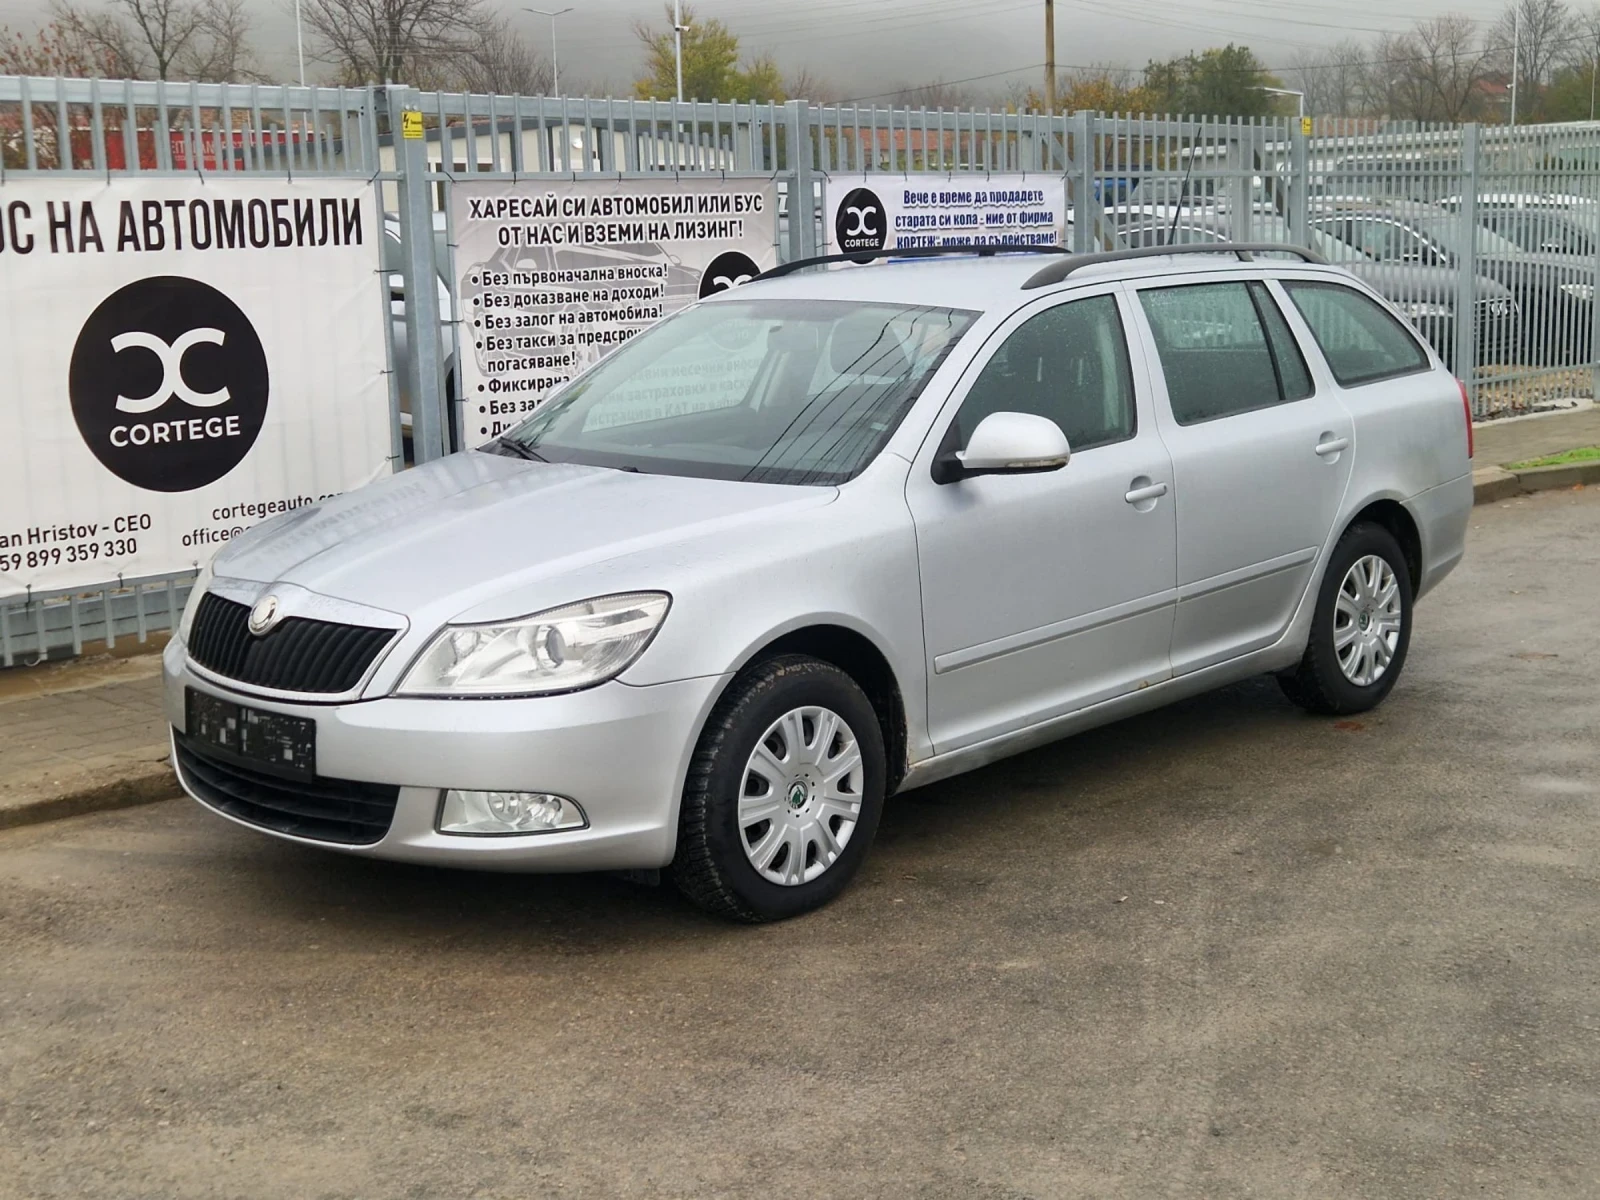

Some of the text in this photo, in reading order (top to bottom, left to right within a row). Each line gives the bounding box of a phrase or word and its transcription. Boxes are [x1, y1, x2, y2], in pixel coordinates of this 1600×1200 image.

[469, 193, 763, 219] ХАРЕСАЙ СИ АВТОМОБИЛ ИЛИ БУС
[904, 190, 1043, 205] Вече е време да продадете
[0, 198, 363, 255] С НА АВТОМОБИЛИ
[895, 215, 937, 228] старата
[939, 214, 951, 226] си
[953, 213, 978, 226] кола
[986, 213, 1005, 225] ние
[1006, 212, 1017, 224] от
[1019, 210, 1054, 224] фирма
[498, 219, 743, 246] ОТ НАС И ВЗЕМИ НА ЛИЗИНГ!
[844, 238, 880, 248] CORTEGE
[943, 236, 971, 246] може
[989, 231, 1057, 246] съдействаме!
[482, 263, 668, 287] Без първоначална вноска!
[483, 284, 664, 308] Без доказване на доходи!
[485, 303, 663, 330] Без залог на автомобила!
[486, 336, 513, 351] Без
[516, 334, 556, 348] такси
[560, 333, 575, 346] за
[487, 351, 576, 373] погасяване!
[489, 400, 516, 415] Без
[109, 415, 241, 447] CORTEGE
[27, 523, 98, 545] Hristov
[113, 513, 152, 533] CEO
[182, 526, 252, 547] office@
[0, 537, 138, 572] 59 899 359 330
